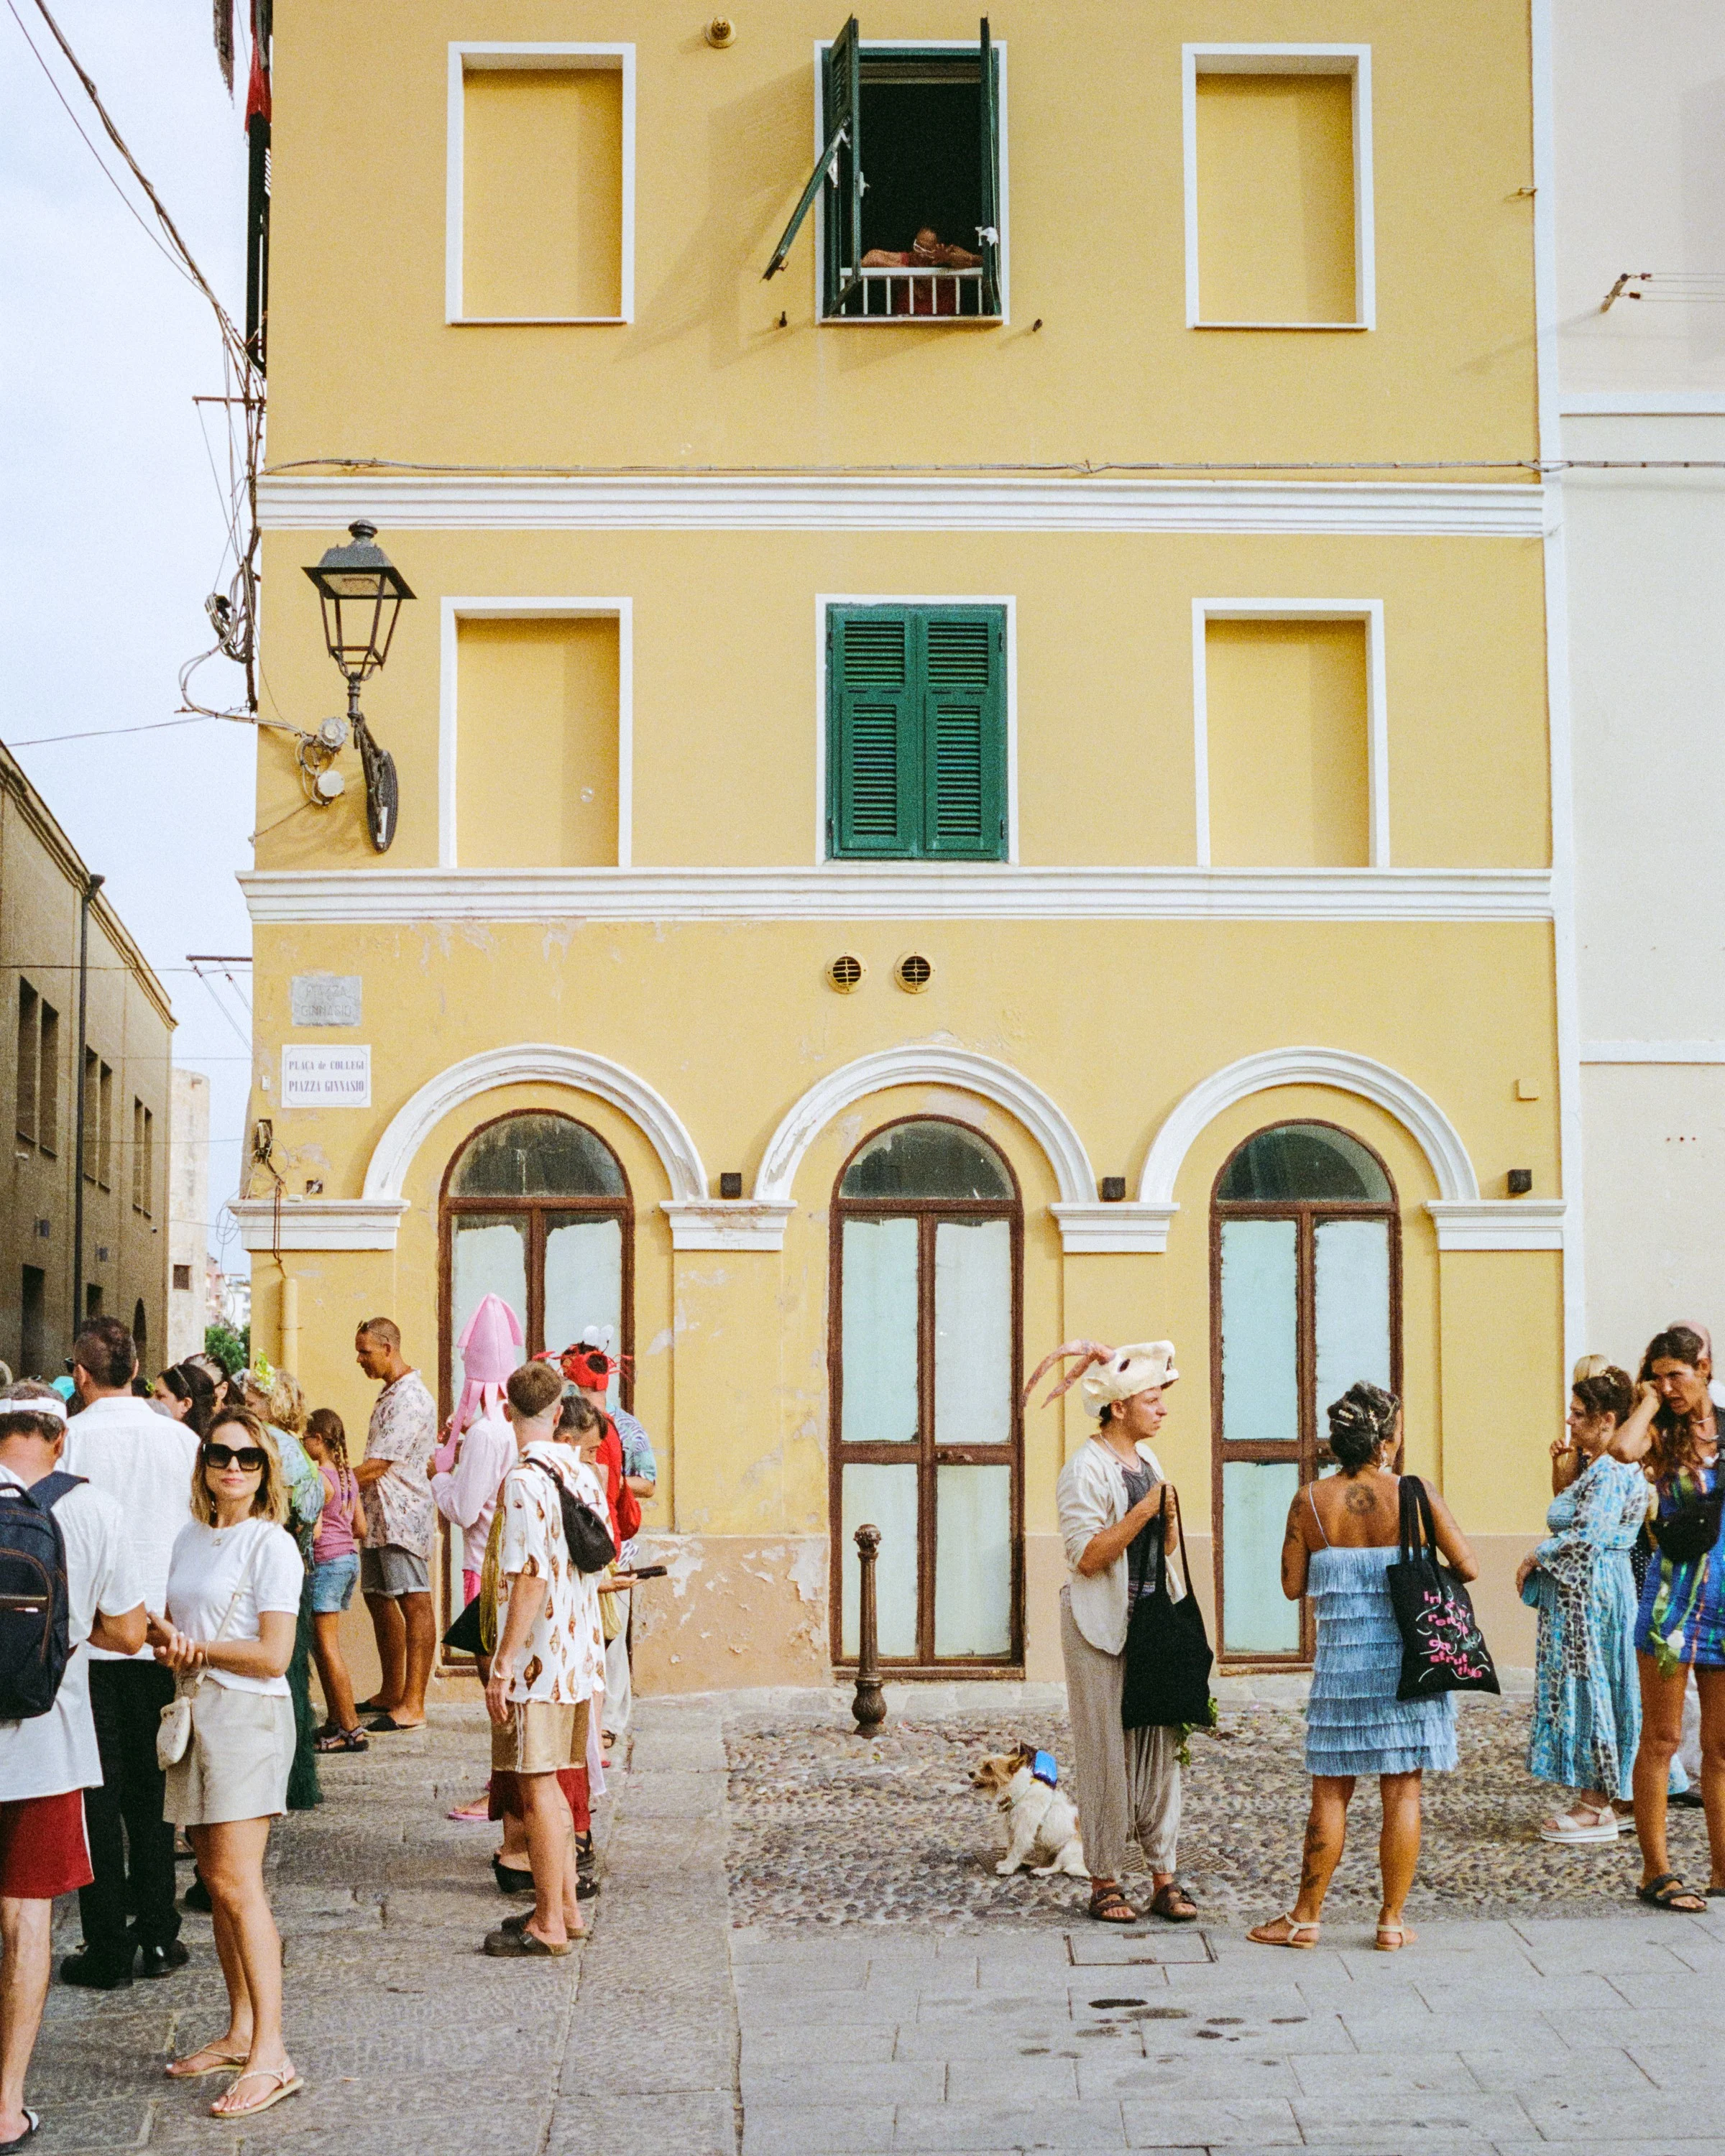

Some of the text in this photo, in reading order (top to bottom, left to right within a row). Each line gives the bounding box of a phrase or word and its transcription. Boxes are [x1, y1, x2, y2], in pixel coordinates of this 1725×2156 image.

[300, 1005, 351, 1017] GINNASIO
[289, 1061, 364, 1072] PLAÇA de COLLEGI
[289, 1081, 364, 1092] PIAZZA GINNASIO
[1430, 1651, 1468, 1665] strut
